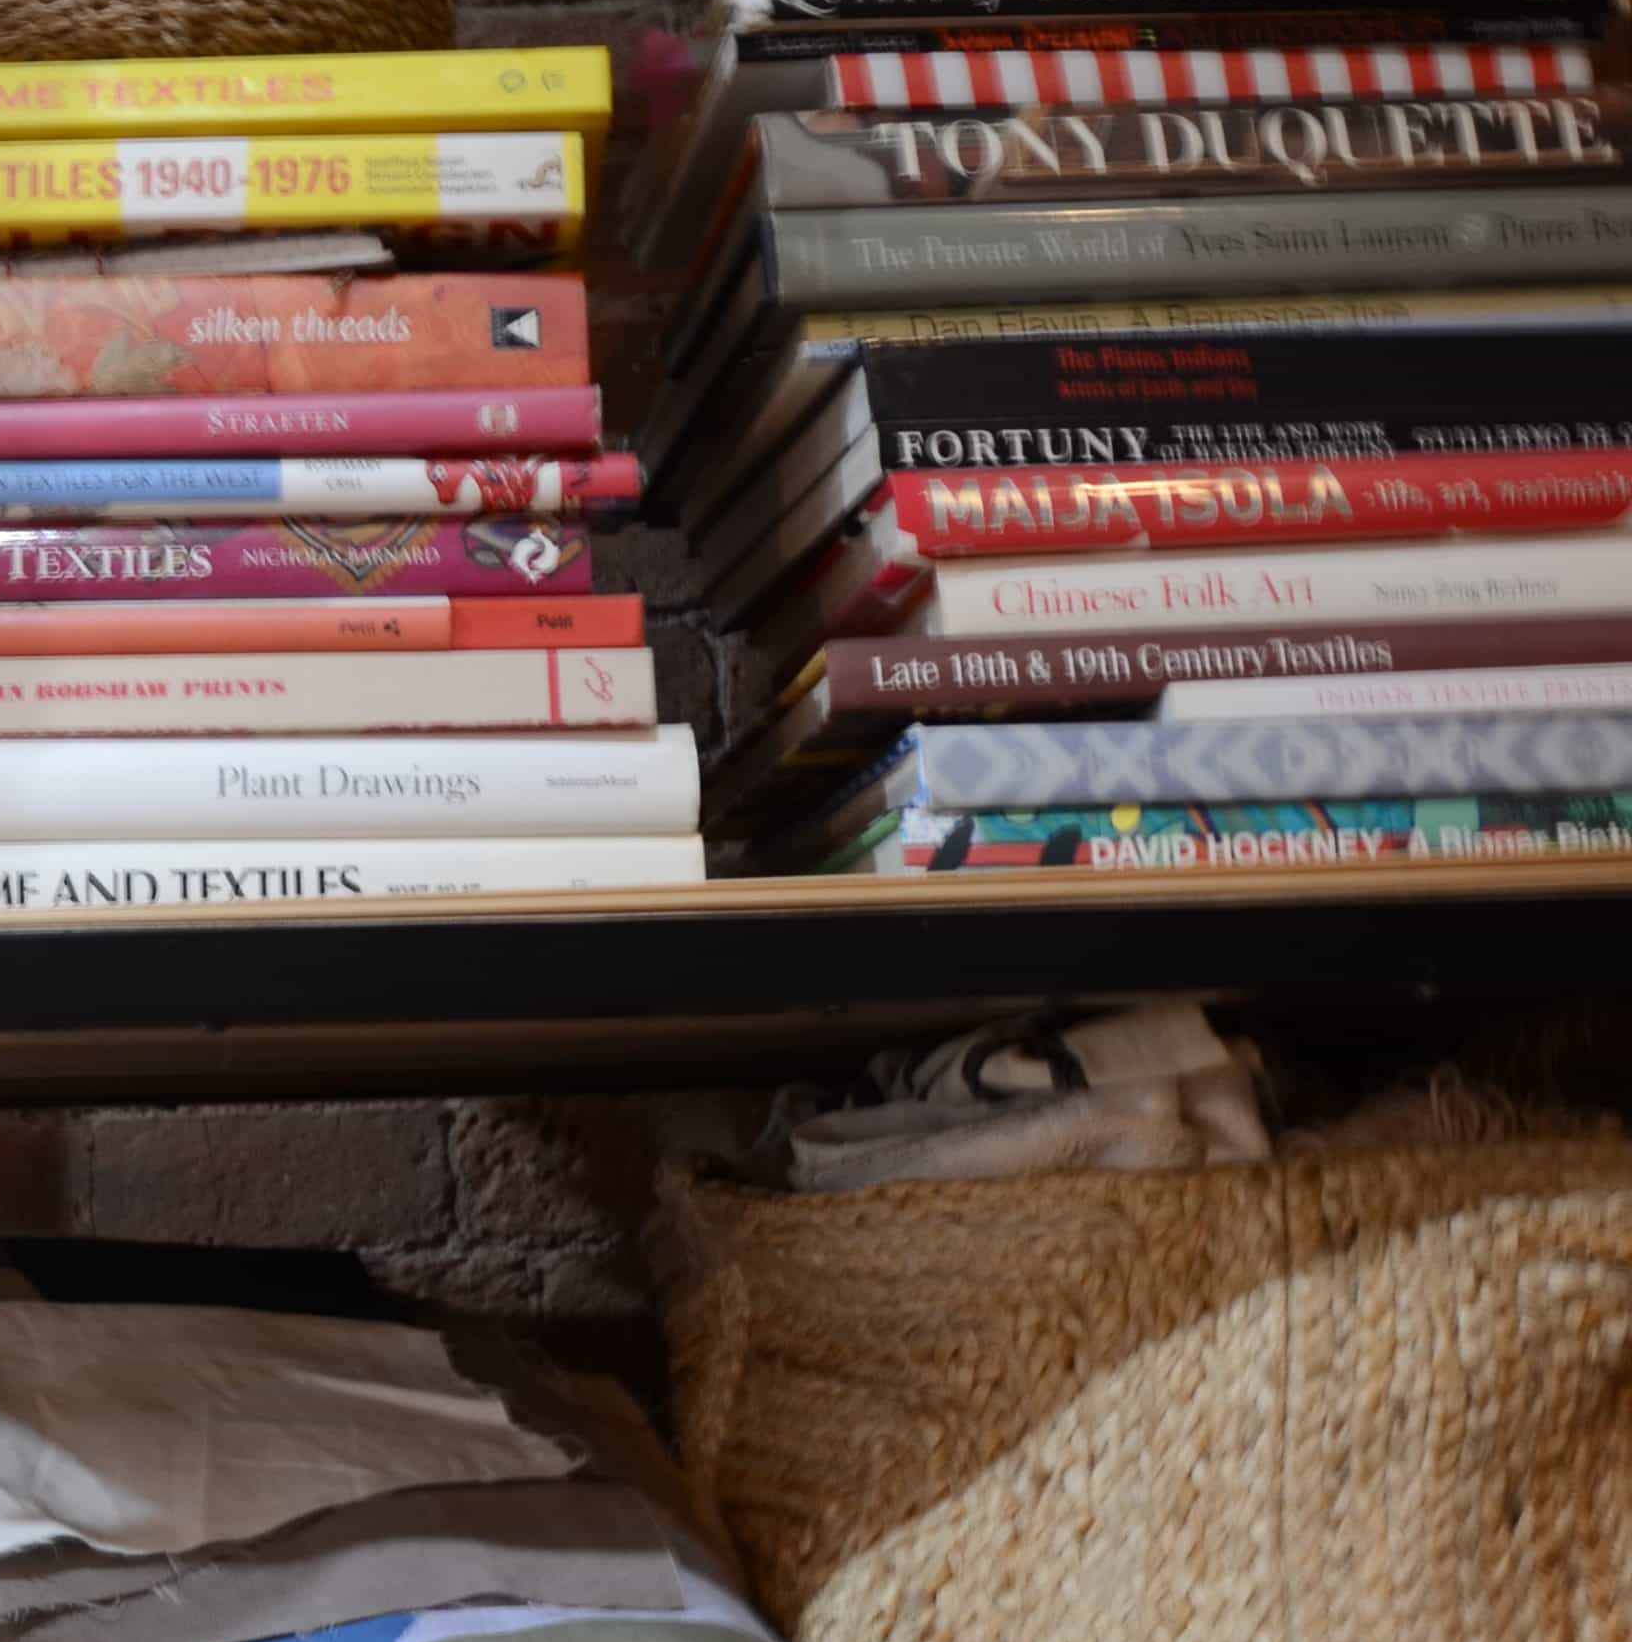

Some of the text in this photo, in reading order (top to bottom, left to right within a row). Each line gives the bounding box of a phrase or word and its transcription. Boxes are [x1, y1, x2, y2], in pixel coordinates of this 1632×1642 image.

[82, 72, 336, 110] TEXTILES
[872, 98, 1624, 189] TONY DUQUETTE
[852, 237, 914, 273] The
[921, 234, 1027, 269] Private
[1036, 228, 1129, 263] World
[1135, 230, 1166, 259] of
[1176, 221, 1244, 258] Yves
[1253, 220, 1329, 255] Saint
[1332, 218, 1451, 255] Laurent
[189, 305, 412, 345] silken threads
[909, 313, 984, 347] Dan
[1056, 346, 1094, 372] The
[894, 425, 1149, 468] FORTUNY
[13, 467, 105, 491] TEXTILES
[111, 467, 153, 489] FOR
[159, 466, 201, 489] THE
[206, 465, 264, 489] WEST
[924, 471, 1140, 535] MAIJA
[1152, 463, 1354, 529] ISOLA
[3, 540, 214, 582] TEXTILES
[990, 569, 1315, 619] Chinese Folk Art
[870, 634, 1394, 692] Late 18th & 19th Century Textiles
[182, 678, 288, 698] PRINTS
[215, 762, 304, 800] Plant
[317, 761, 482, 805] Drawings
[1089, 833, 1198, 871] DAVID
[1206, 826, 1384, 865] HOCKNEY
[1408, 825, 1431, 859] A
[50, 867, 160, 909] AND
[169, 865, 363, 904] TEXTILES
